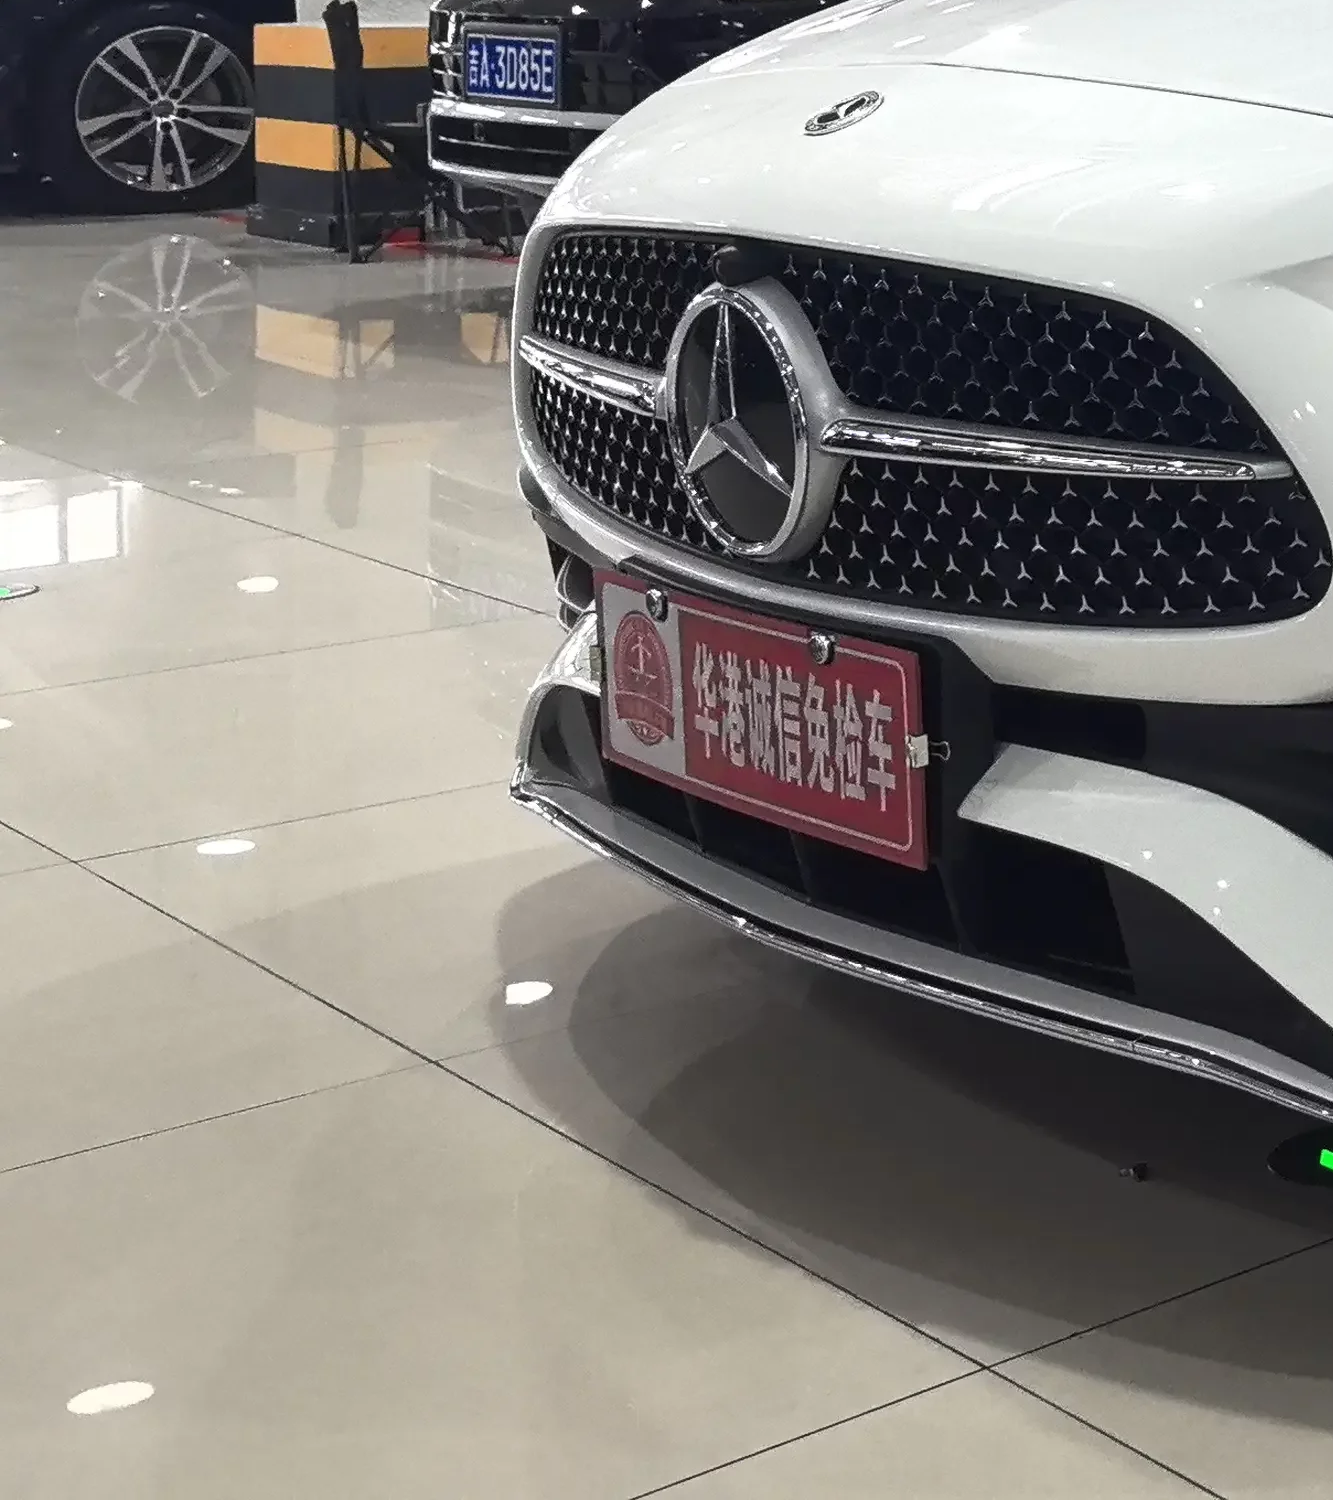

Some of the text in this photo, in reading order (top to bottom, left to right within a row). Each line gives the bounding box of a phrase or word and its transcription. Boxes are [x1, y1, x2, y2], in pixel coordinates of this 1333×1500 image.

[693, 642, 897, 813] 华港诚信免检车
